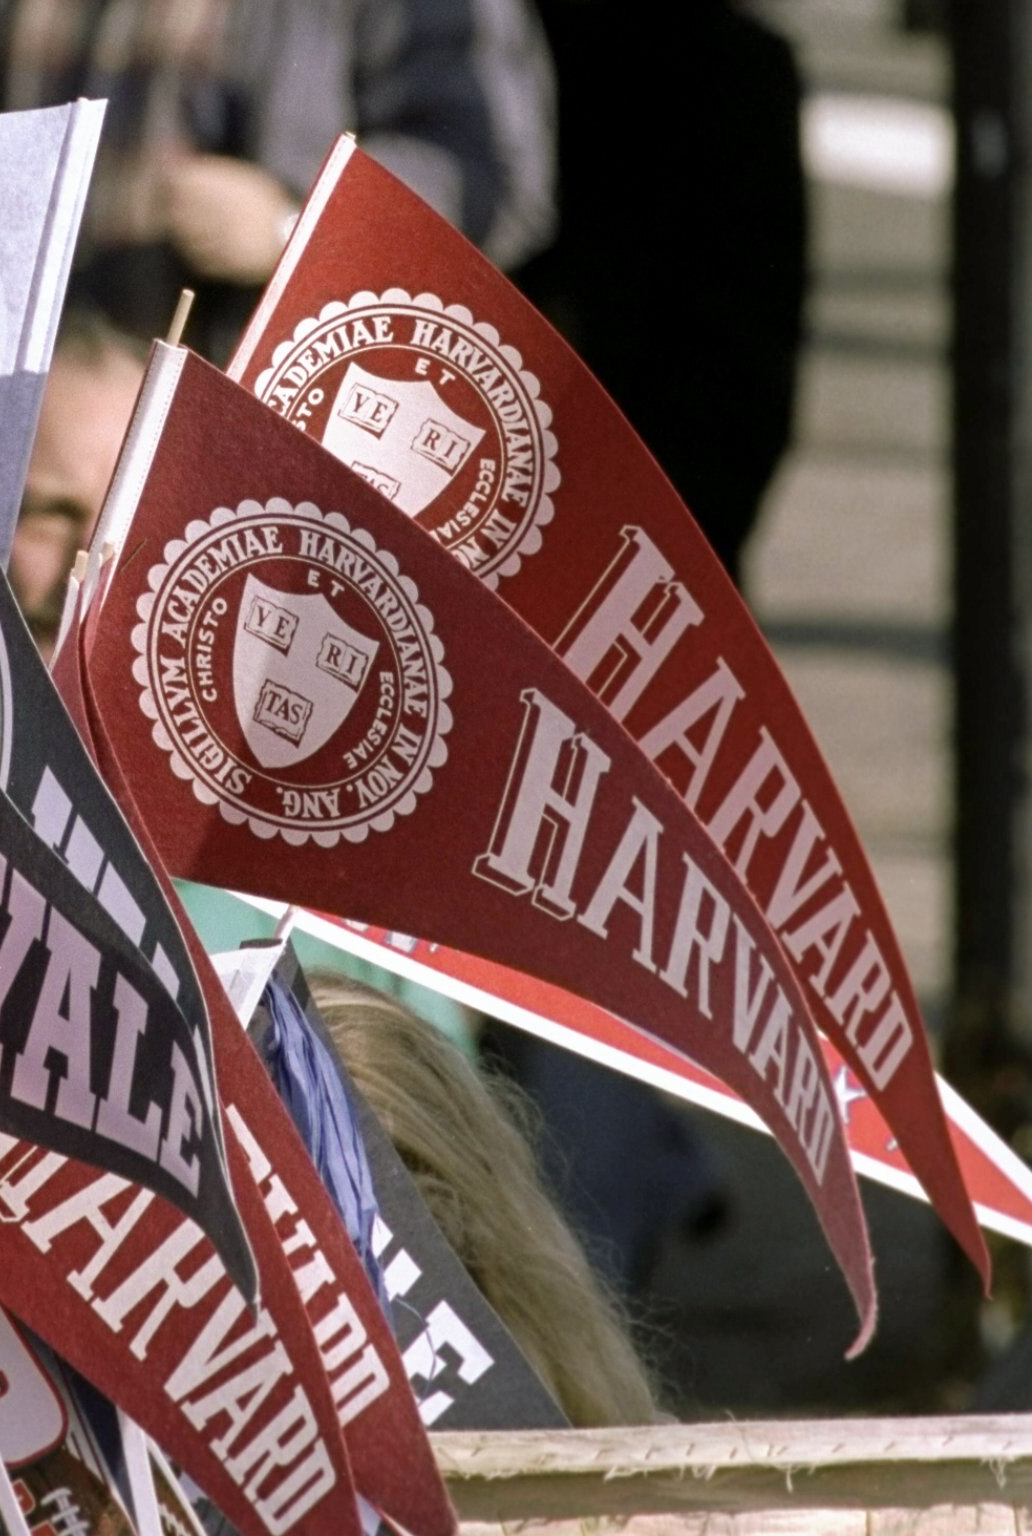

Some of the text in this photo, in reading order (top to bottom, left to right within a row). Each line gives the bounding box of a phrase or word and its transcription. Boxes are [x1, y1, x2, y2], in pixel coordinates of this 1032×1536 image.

[422, 428, 459, 460] RI
[481, 507, 518, 550] IN
[161, 525, 283, 649] ACADEMIAE
[298, 528, 428, 721] HARVARDIANAE
[392, 721, 425, 766] IN
[195, 597, 228, 703] CHRISTO
[342, 670, 396, 770] ECCLESIAE
[325, 642, 360, 678] RI
[264, 691, 305, 727] TAS
[551, 525, 913, 1092] HARVARD
[472, 688, 836, 1187] HARVARD
